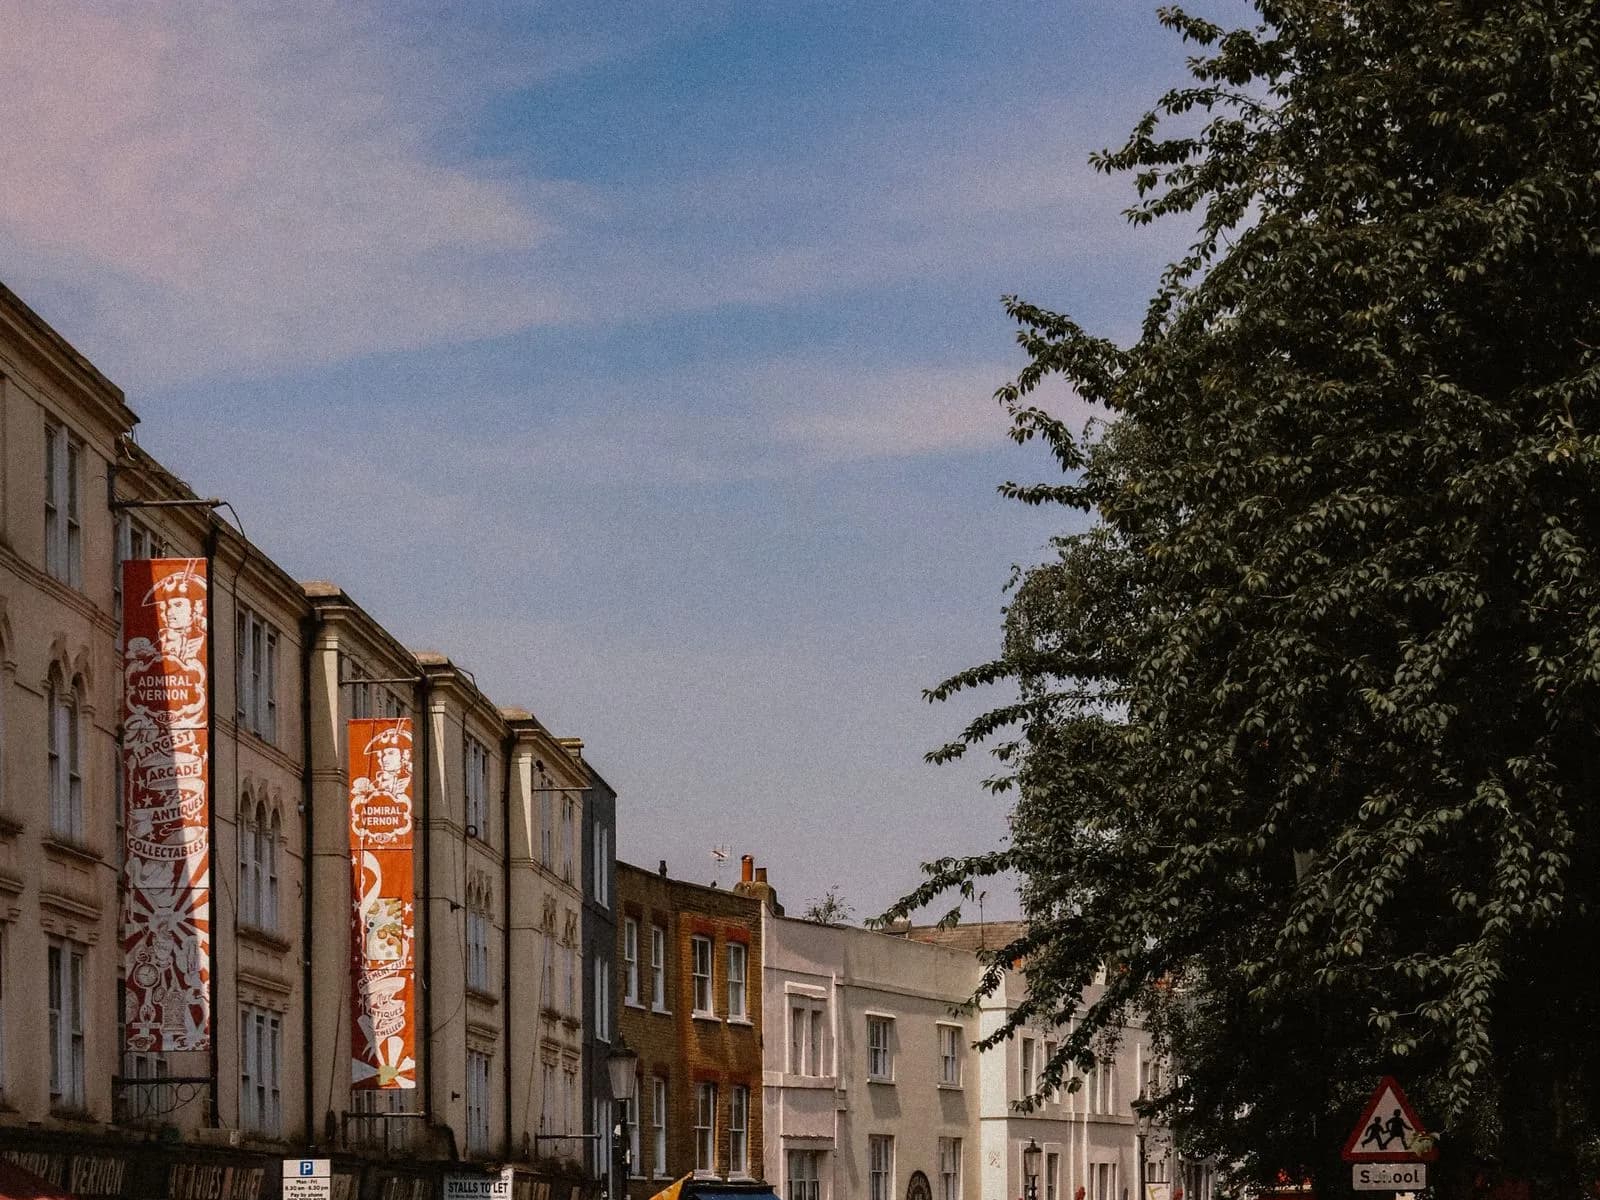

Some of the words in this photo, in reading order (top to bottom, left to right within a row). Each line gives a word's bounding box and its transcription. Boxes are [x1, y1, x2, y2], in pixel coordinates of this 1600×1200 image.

[138, 675, 193, 687] ADMIRAL
[139, 689, 189, 701] VERNON
[137, 731, 192, 760] LARGEST
[150, 764, 199, 781] ARCADE
[152, 794, 203, 822] ANTIQUES
[361, 806, 403, 816] ADMIRAL
[362, 816, 399, 826] VERNON
[128, 838, 204, 858] COLLECTABLES
[367, 1007, 404, 1020] ANTIQUES
[71, 1153, 127, 1195] VERNON
[447, 1182, 477, 1193] STALLS
[480, 1182, 491, 1193] TO
[493, 1182, 509, 1193] LET
